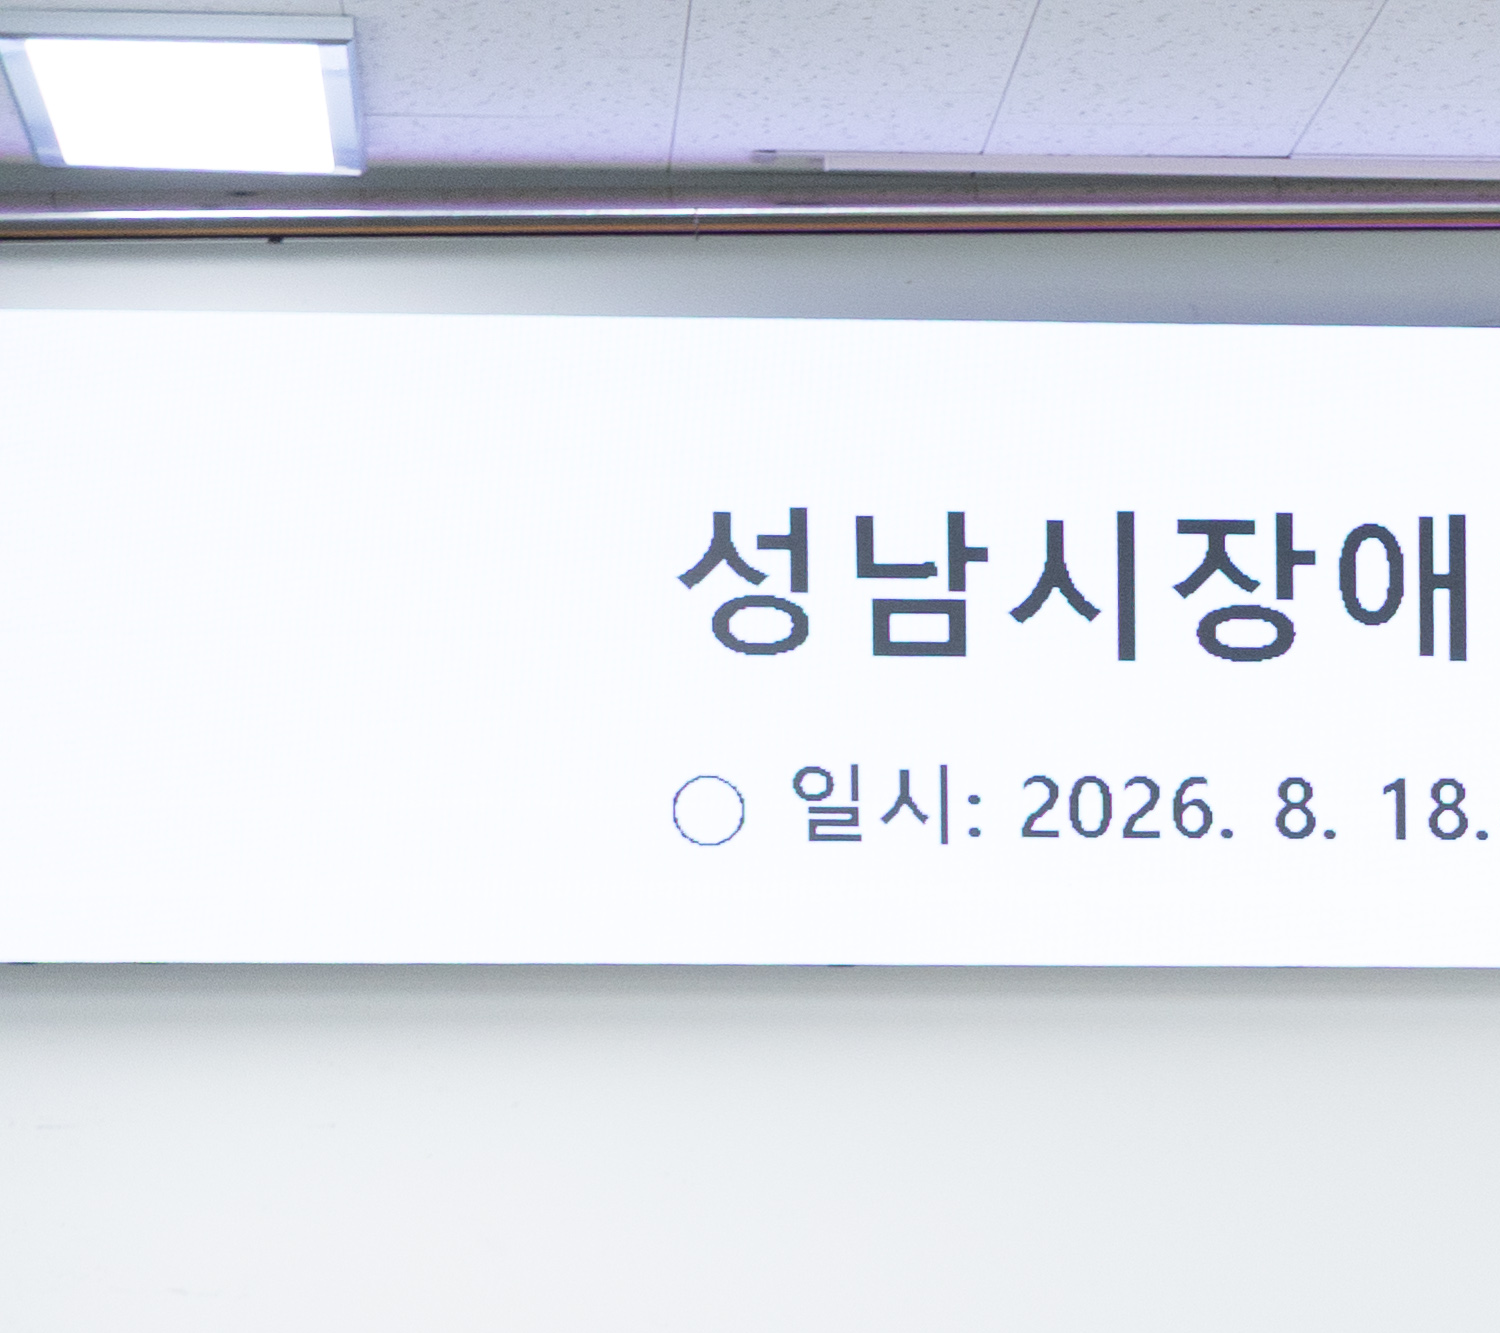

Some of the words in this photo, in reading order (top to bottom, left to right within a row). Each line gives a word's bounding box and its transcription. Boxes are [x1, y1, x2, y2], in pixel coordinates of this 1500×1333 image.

[791, 762, 981, 845] 일시:
[1020, 773, 1234, 840] 2026.
[1274, 774, 1337, 841] 8.
